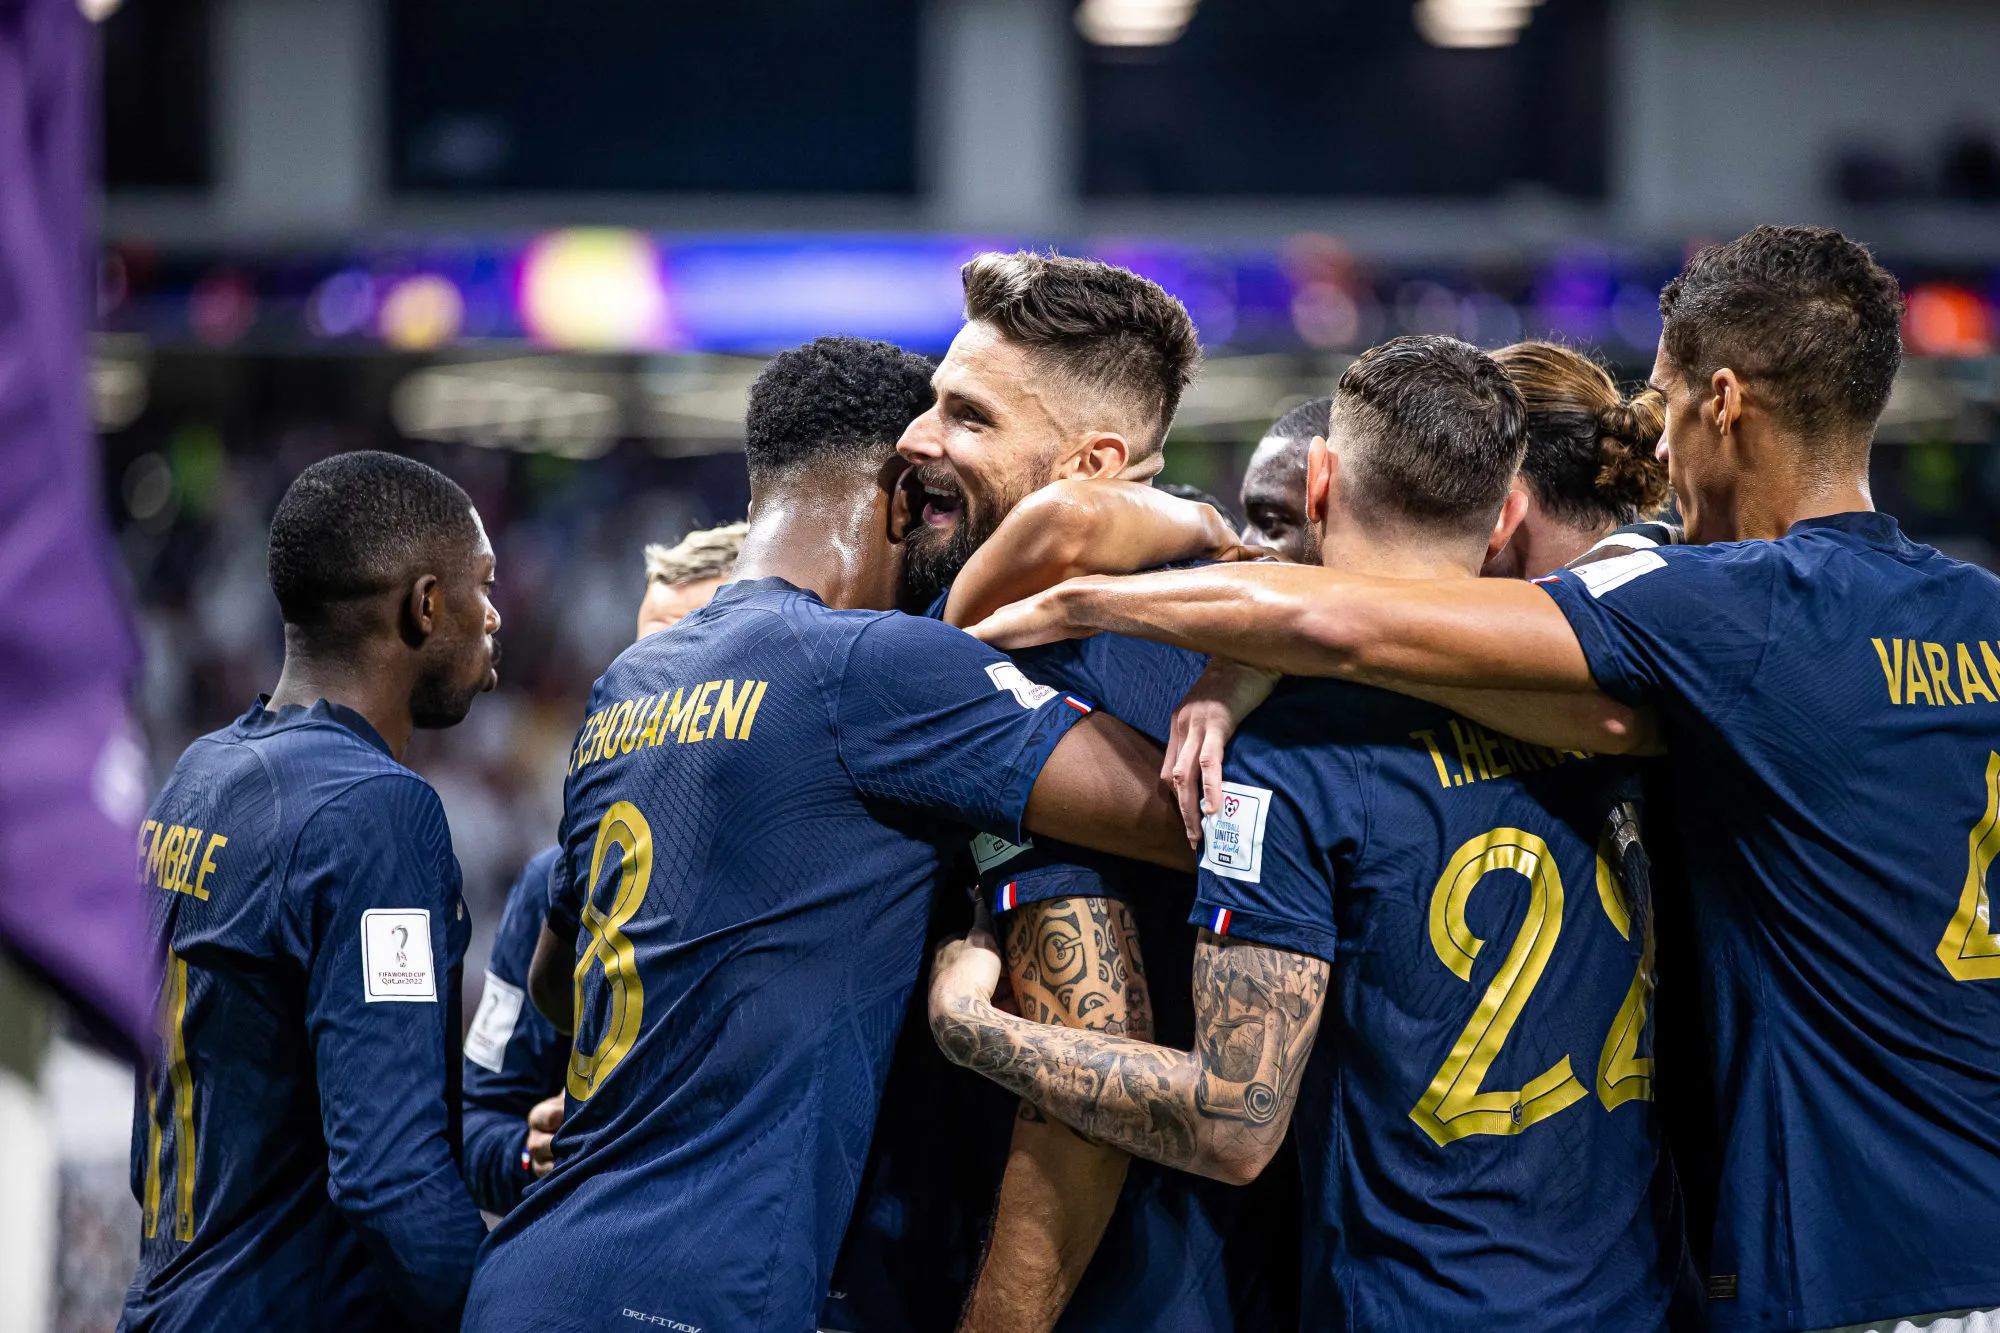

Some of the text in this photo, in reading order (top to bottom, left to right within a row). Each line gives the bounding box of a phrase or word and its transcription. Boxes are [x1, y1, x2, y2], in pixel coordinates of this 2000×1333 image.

[139, 819, 228, 901] EMBELE
[1214, 829, 1240, 845] UNITES
[567, 801, 653, 1101] 8
